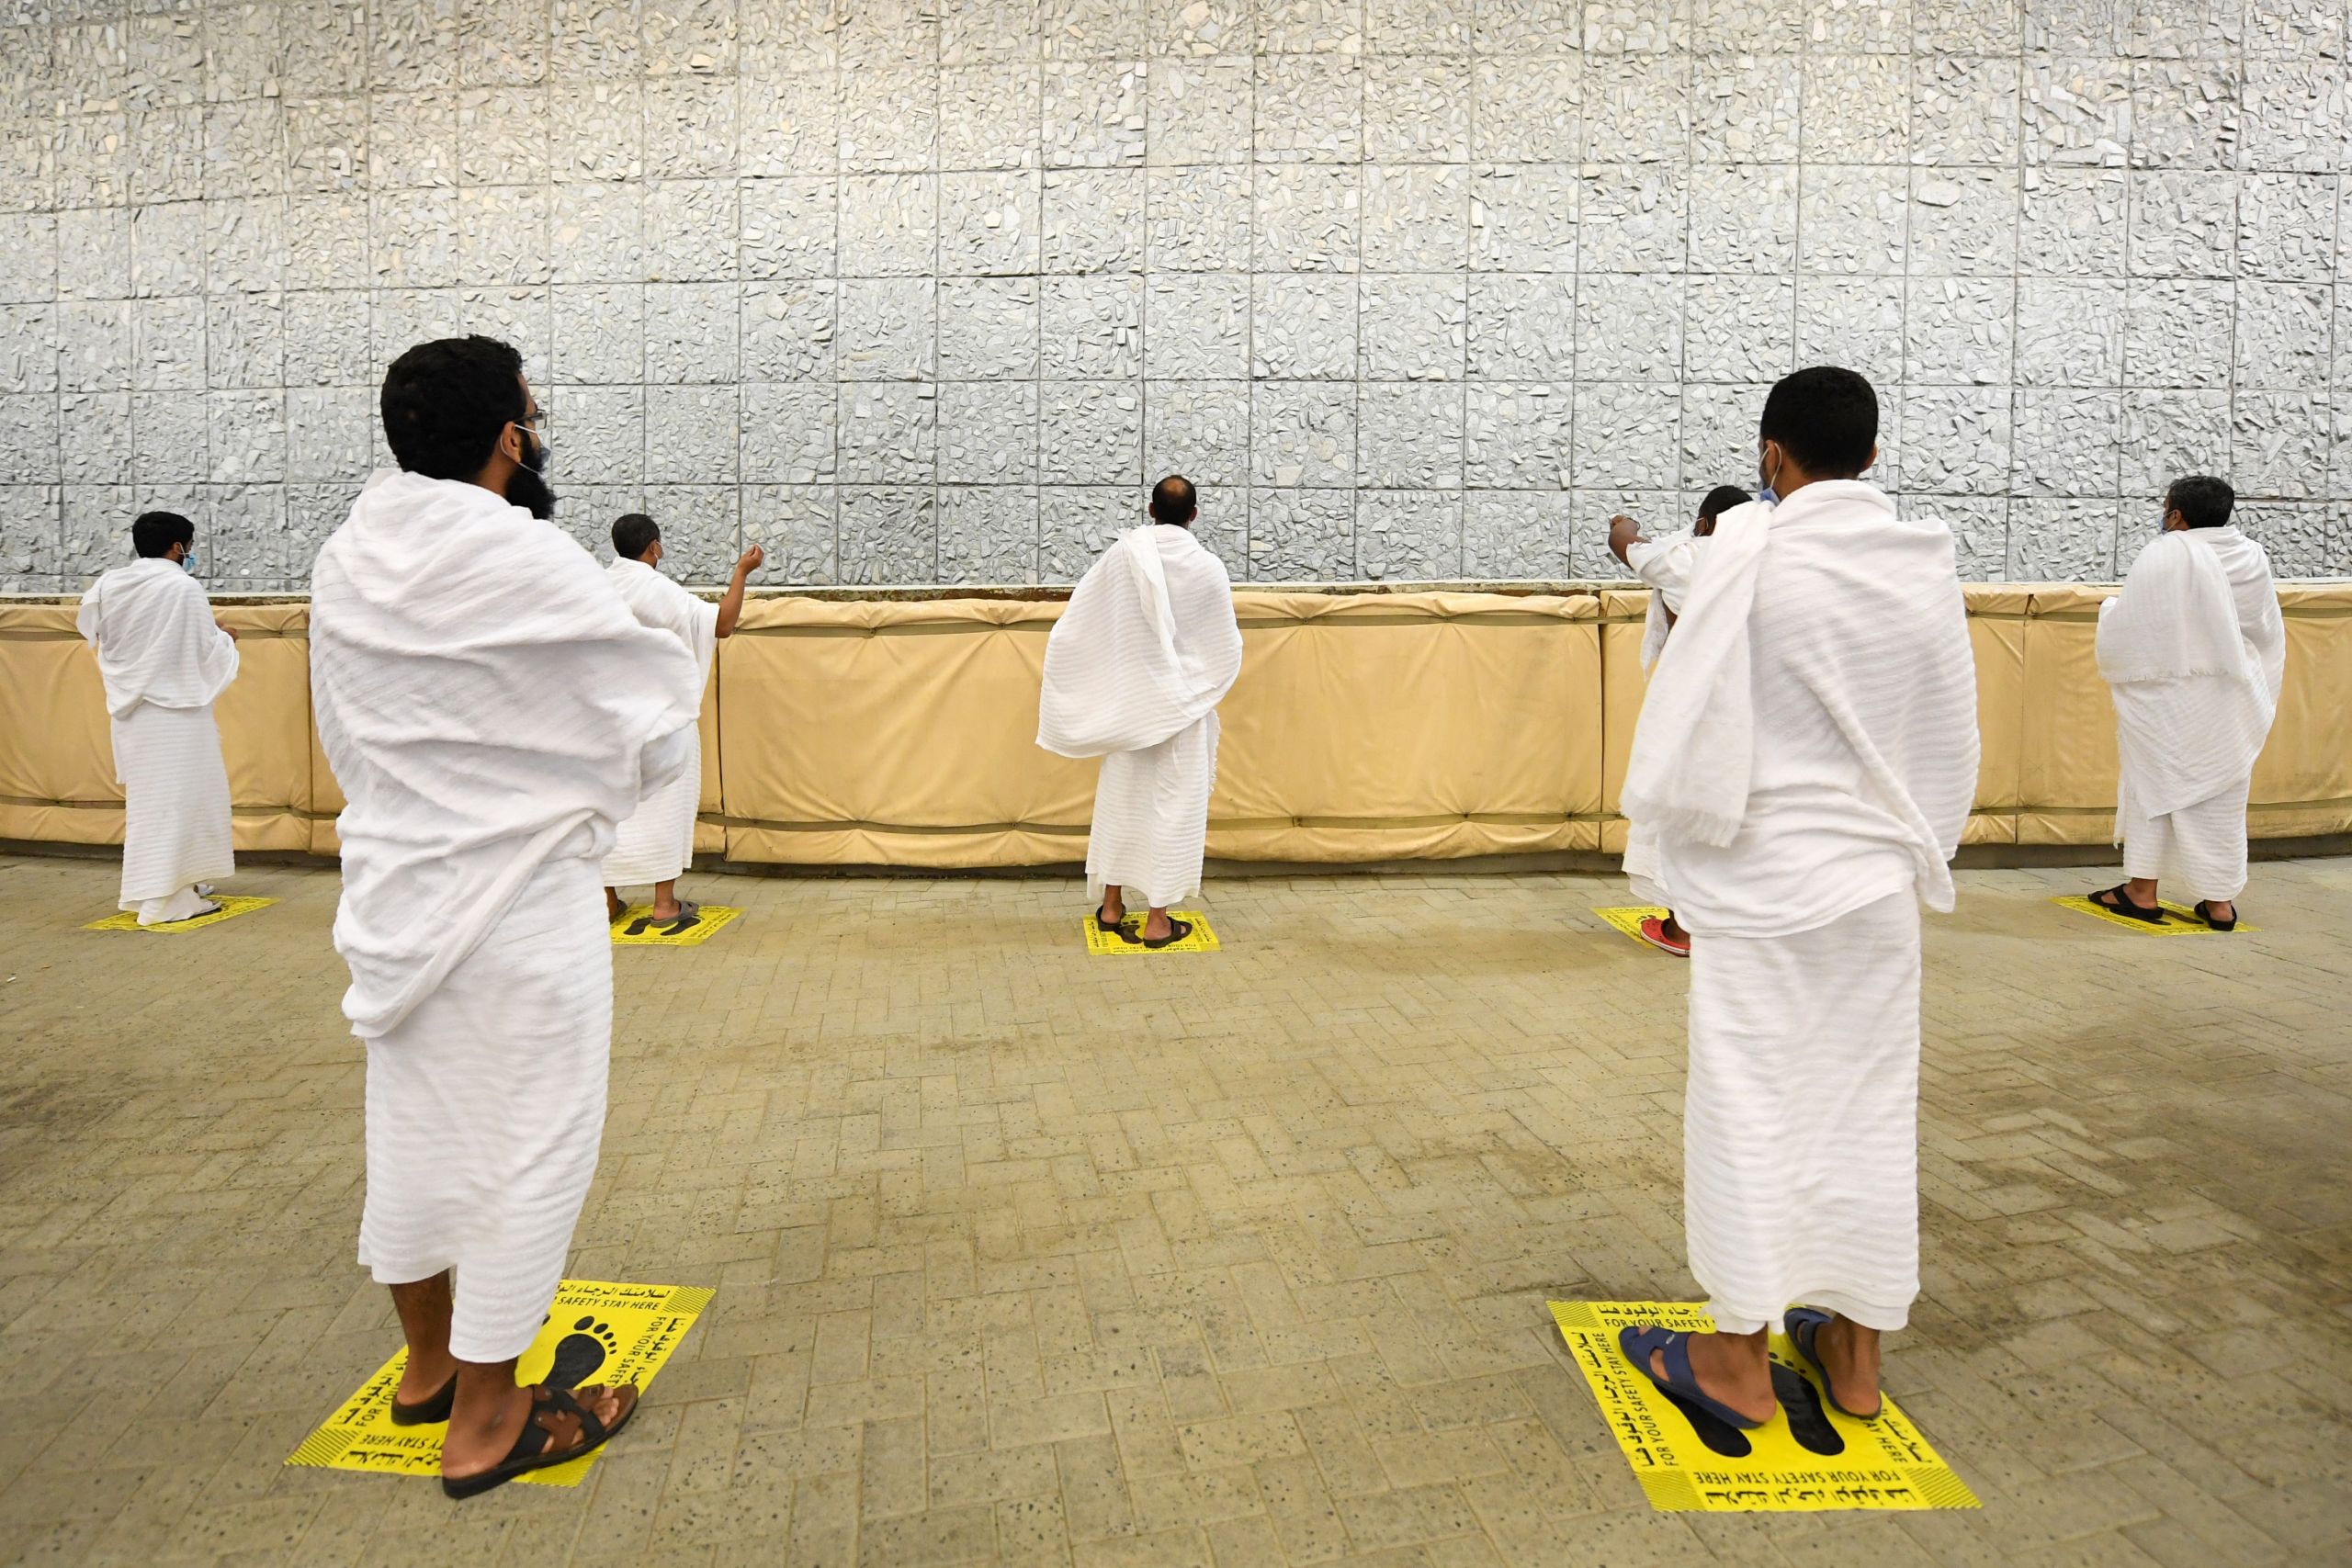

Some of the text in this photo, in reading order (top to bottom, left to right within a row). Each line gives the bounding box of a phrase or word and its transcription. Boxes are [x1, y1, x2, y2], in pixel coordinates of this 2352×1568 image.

[558, 1296, 661, 1311] SAFETY STAY HERE
[1604, 1318, 1710, 1328] FOR YOUR SAFETY
[607, 1316, 667, 1386] FOR YOUR SAFET
[1592, 1333, 1679, 1467] FOR YOUR SAFETY STAY HERE
[355, 1408, 382, 1427] FOR
[359, 1434, 395, 1446] HERE
[395, 1437, 430, 1450] STAY
[1875, 1437, 1908, 1462] HERE
[1693, 1471, 1902, 1484] FOR YOUR SAFETY STAY HERE
